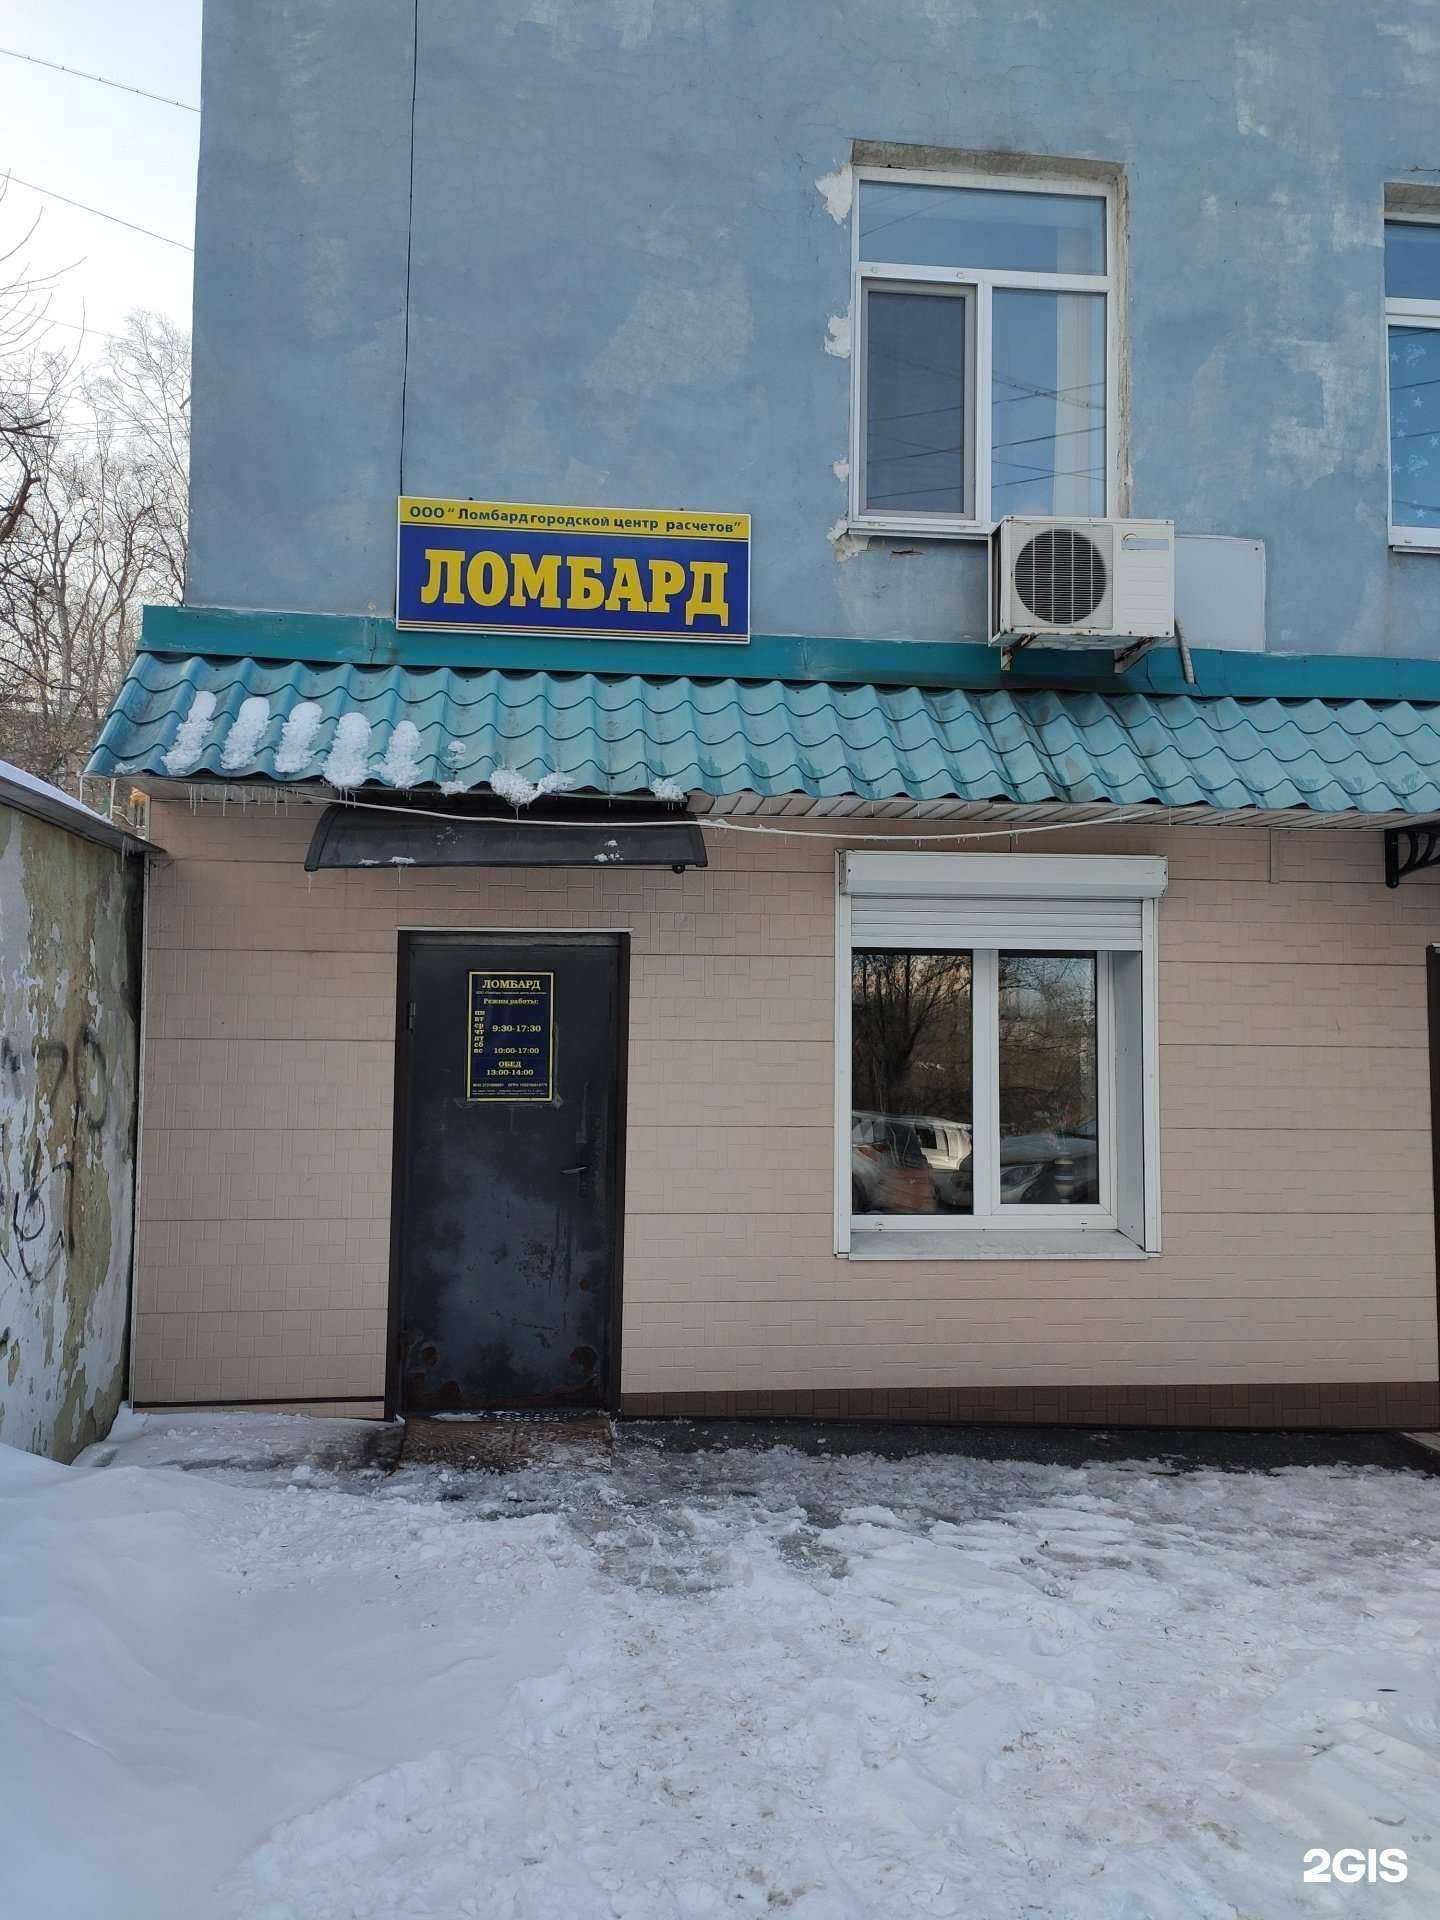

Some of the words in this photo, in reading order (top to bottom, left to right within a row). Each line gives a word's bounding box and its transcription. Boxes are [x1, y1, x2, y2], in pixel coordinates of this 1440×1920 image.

[410, 506, 444, 518] ООО
[614, 517, 658, 531] центр
[420, 548, 729, 627] ЛОМБАРД
[482, 980, 541, 990] ЛОМБАРД
[498, 1060, 522, 1068] ОБЕД
